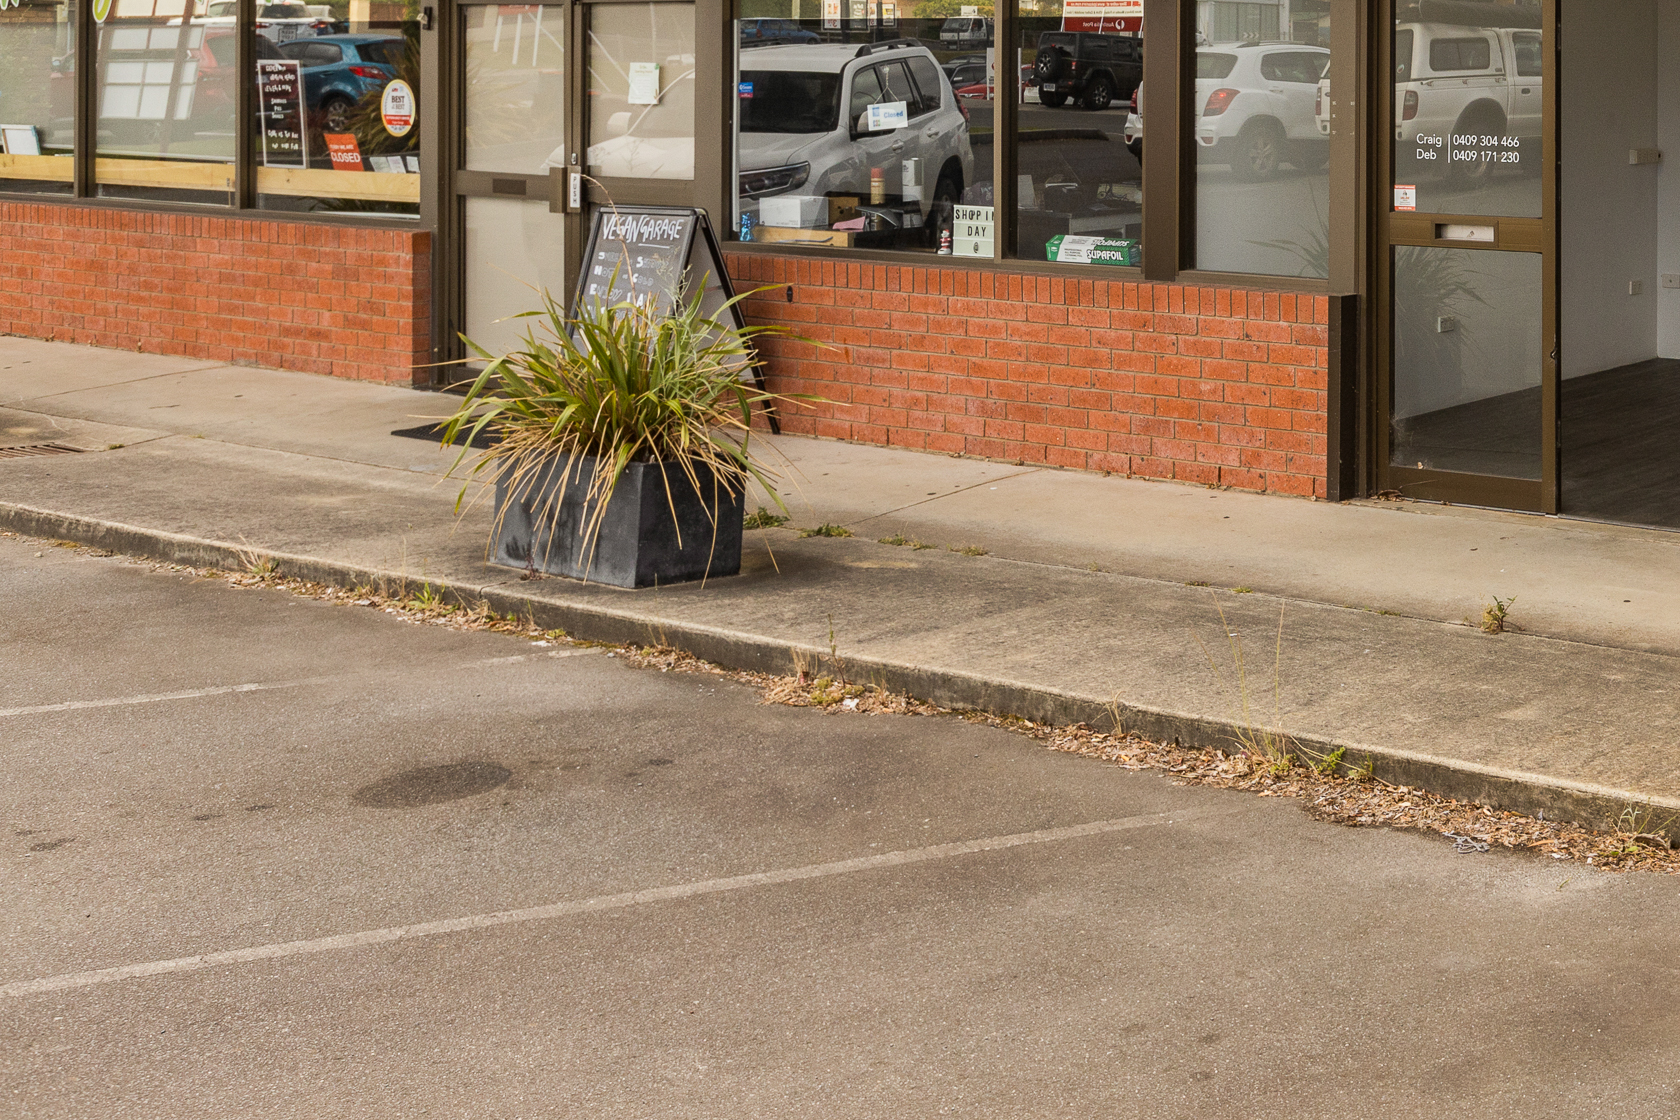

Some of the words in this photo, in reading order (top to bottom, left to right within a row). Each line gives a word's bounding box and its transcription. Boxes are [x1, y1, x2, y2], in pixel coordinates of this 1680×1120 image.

[391, 95, 405, 103] BEST
[883, 110, 904, 119] Closed
[1416, 133, 1442, 148] Craig
[1452, 134, 1477, 146] 0409
[1479, 135, 1499, 147] 304
[1500, 136, 1520, 148] 466
[331, 152, 361, 163] CLOSED
[1416, 148, 1437, 160] Deb
[1452, 150, 1477, 161] 0409
[1480, 151, 1497, 162] 171
[1500, 151, 1520, 163] 230
[603, 214, 640, 243] VEGAN
[639, 214, 685, 242] GARAGE
[967, 226, 986, 237] DAY
[1086, 249, 1124, 261] SUPAFOIL
